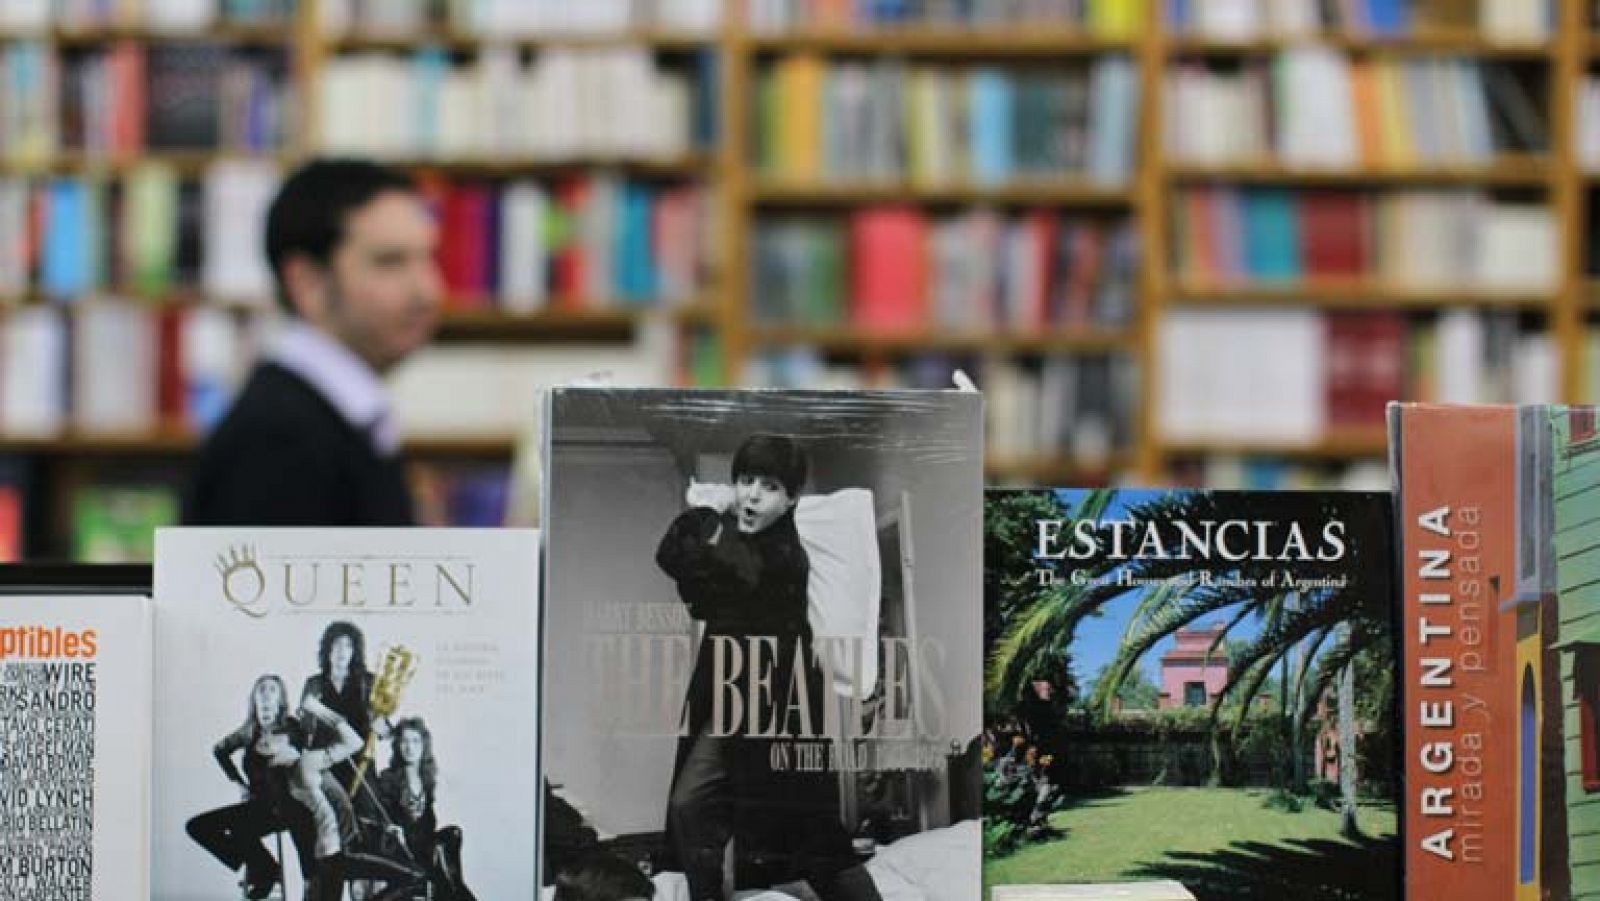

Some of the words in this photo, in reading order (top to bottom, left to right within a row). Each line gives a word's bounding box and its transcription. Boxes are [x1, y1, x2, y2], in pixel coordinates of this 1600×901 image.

[1035, 519, 1346, 562] ESTANCIAS
[214, 541, 477, 617] QUEEN
[1456, 505, 1486, 672] pensada
[43, 663, 96, 682] WIRE
[583, 634, 692, 737] THE
[708, 634, 948, 738] BEATLES
[1418, 505, 1454, 859] ARGENTINA
[16, 692, 95, 711] SANDRO
[1463, 693, 1490, 719] y
[770, 742, 789, 770] ON
[794, 742, 824, 771] THE
[36, 788, 93, 808] LYNCH
[1455, 732, 1484, 863] mirada
[19, 857, 92, 876] BURTON
